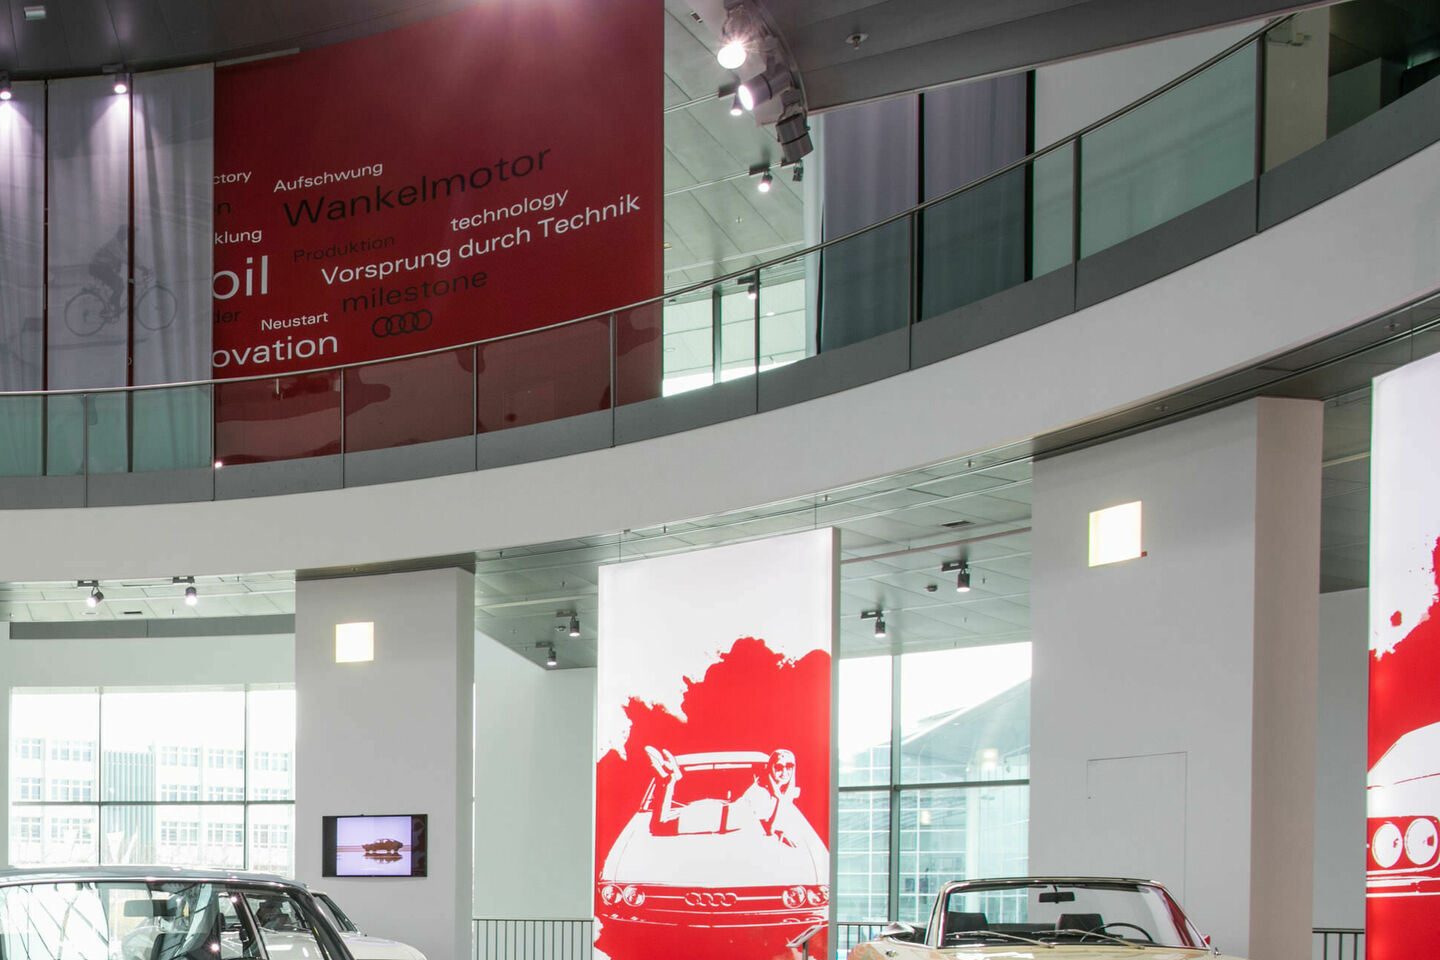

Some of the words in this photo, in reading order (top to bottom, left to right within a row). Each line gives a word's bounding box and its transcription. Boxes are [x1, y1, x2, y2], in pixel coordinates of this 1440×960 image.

[273, 163, 384, 193] Aufschwung
[283, 148, 552, 227] Wankelmotor
[450, 189, 569, 231] technology
[214, 230, 263, 245] klung
[293, 236, 395, 263] Produktion
[321, 248, 451, 285] Vorsprung
[458, 227, 531, 258] durch
[537, 194, 641, 238] Technik
[342, 271, 488, 313] milestone
[261, 312, 329, 331] Neustart
